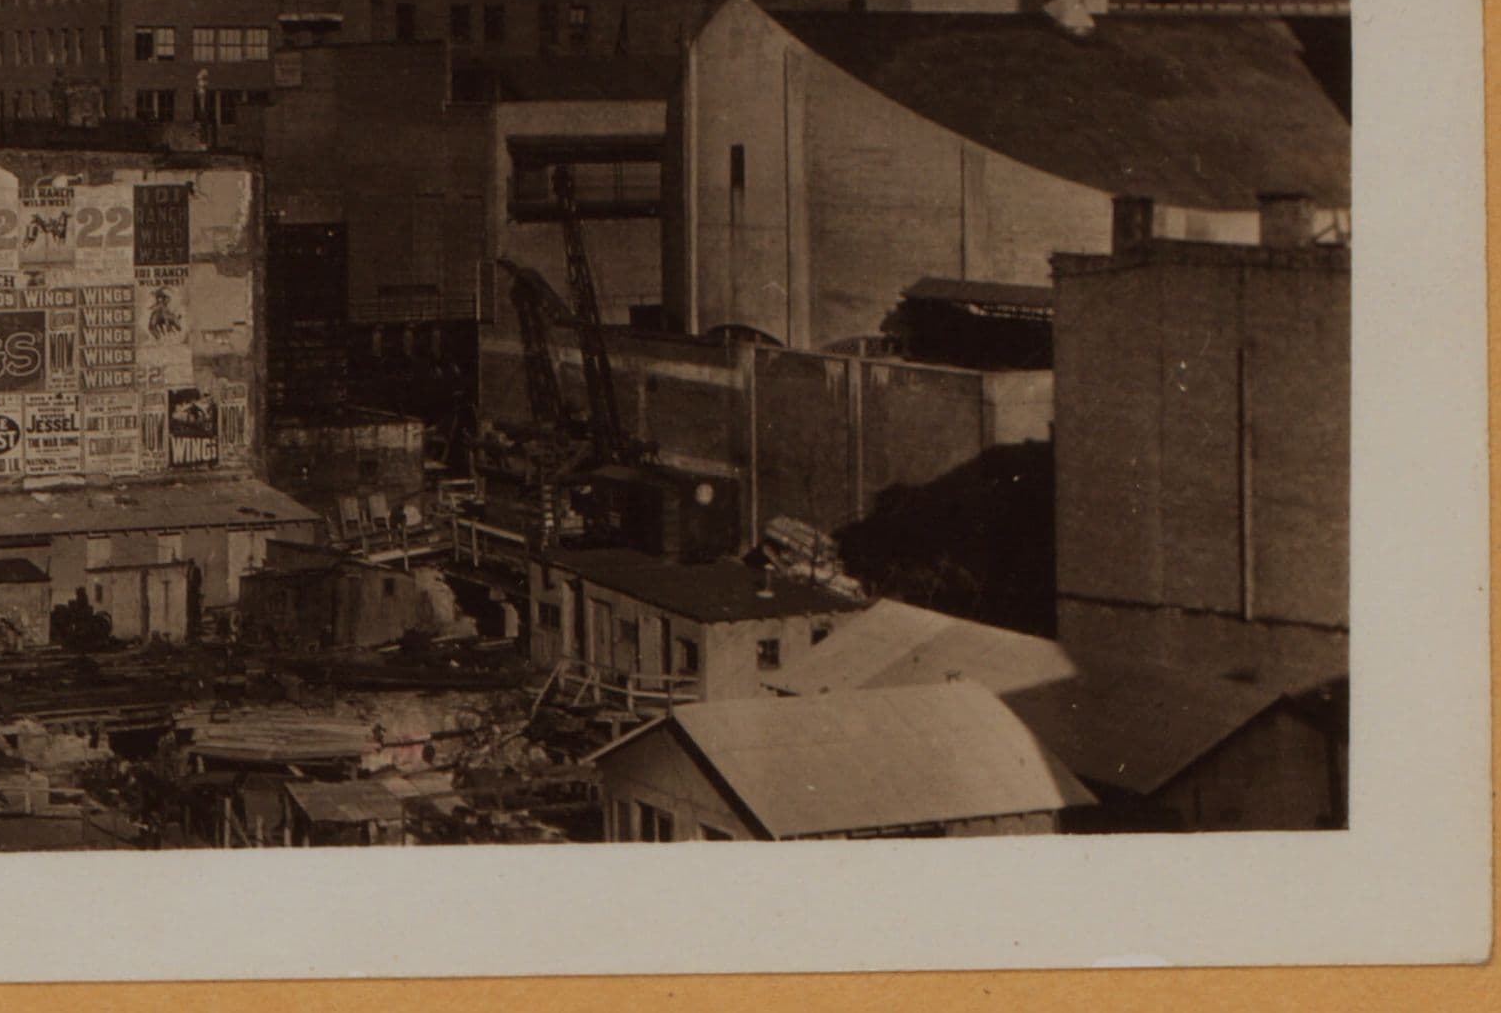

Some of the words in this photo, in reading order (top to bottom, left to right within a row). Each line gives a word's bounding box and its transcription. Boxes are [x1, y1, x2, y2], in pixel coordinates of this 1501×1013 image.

[38, 187, 75, 198] RANCH
[141, 187, 181, 204] 101
[23, 199, 46, 207] WILD
[48, 199, 71, 207] WEST
[134, 207, 189, 225] RANCH
[76, 206, 133, 248] 22
[140, 227, 184, 245] WILD
[139, 247, 184, 263] WEST
[152, 267, 189, 278] RANCH
[138, 279, 161, 287] WILD
[163, 278, 185, 286] WEST
[23, 289, 74, 308] WINGS
[82, 288, 132, 307] WINGS
[82, 308, 132, 326] WINGS
[82, 327, 132, 346] WINGS
[83, 348, 133, 366] WINGS
[83, 369, 133, 388] WINGS
[26, 413, 80, 433] JESSEL
[27, 437, 40, 449] THE
[42, 437, 58, 448] WAR
[171, 436, 217, 464] WINGS
